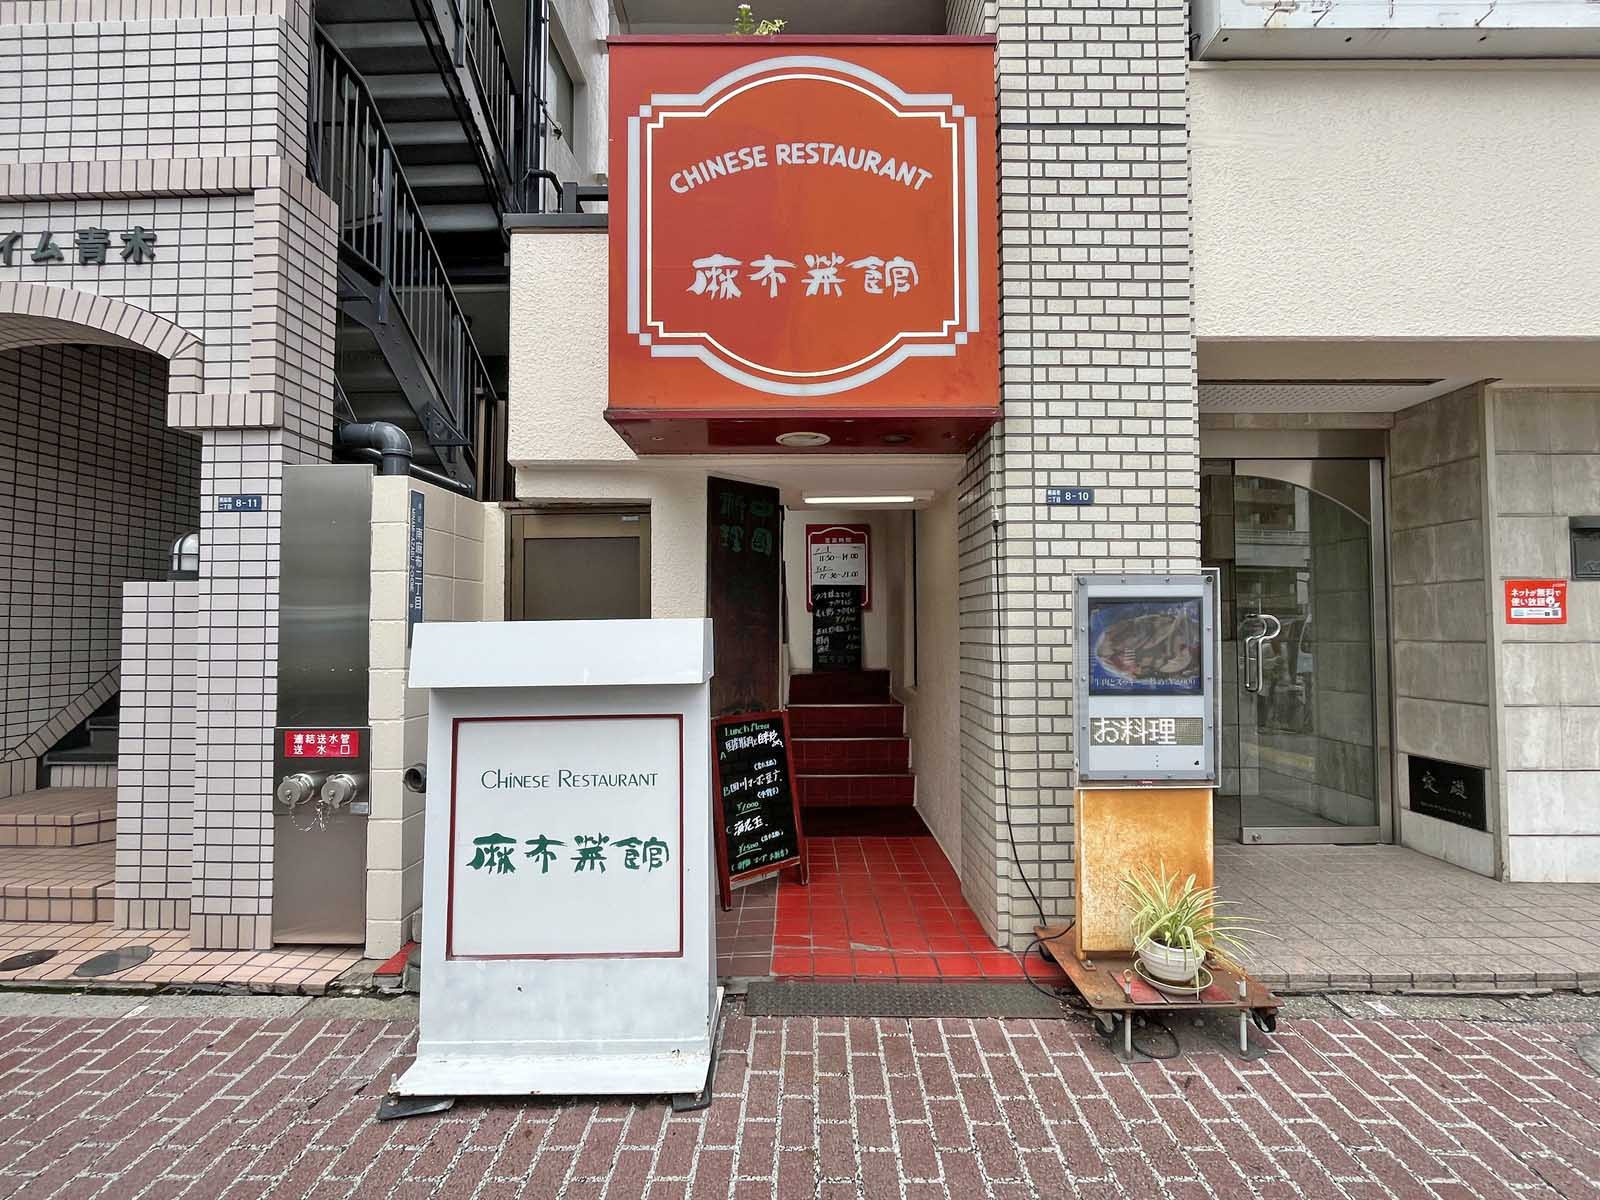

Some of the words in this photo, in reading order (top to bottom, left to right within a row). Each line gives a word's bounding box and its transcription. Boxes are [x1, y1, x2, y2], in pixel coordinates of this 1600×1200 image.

[670, 145, 768, 193] CHINESE
[776, 142, 933, 190] RESTAURANT
[686, 252, 919, 300] 麻布菜館
[235, 499, 257, 508] 8-11
[1065, 491, 1089, 501] 8-10
[293, 733, 350, 744] 連結送水管
[1094, 717, 1177, 745] お料理
[466, 832, 669, 874] 麻布菜館
